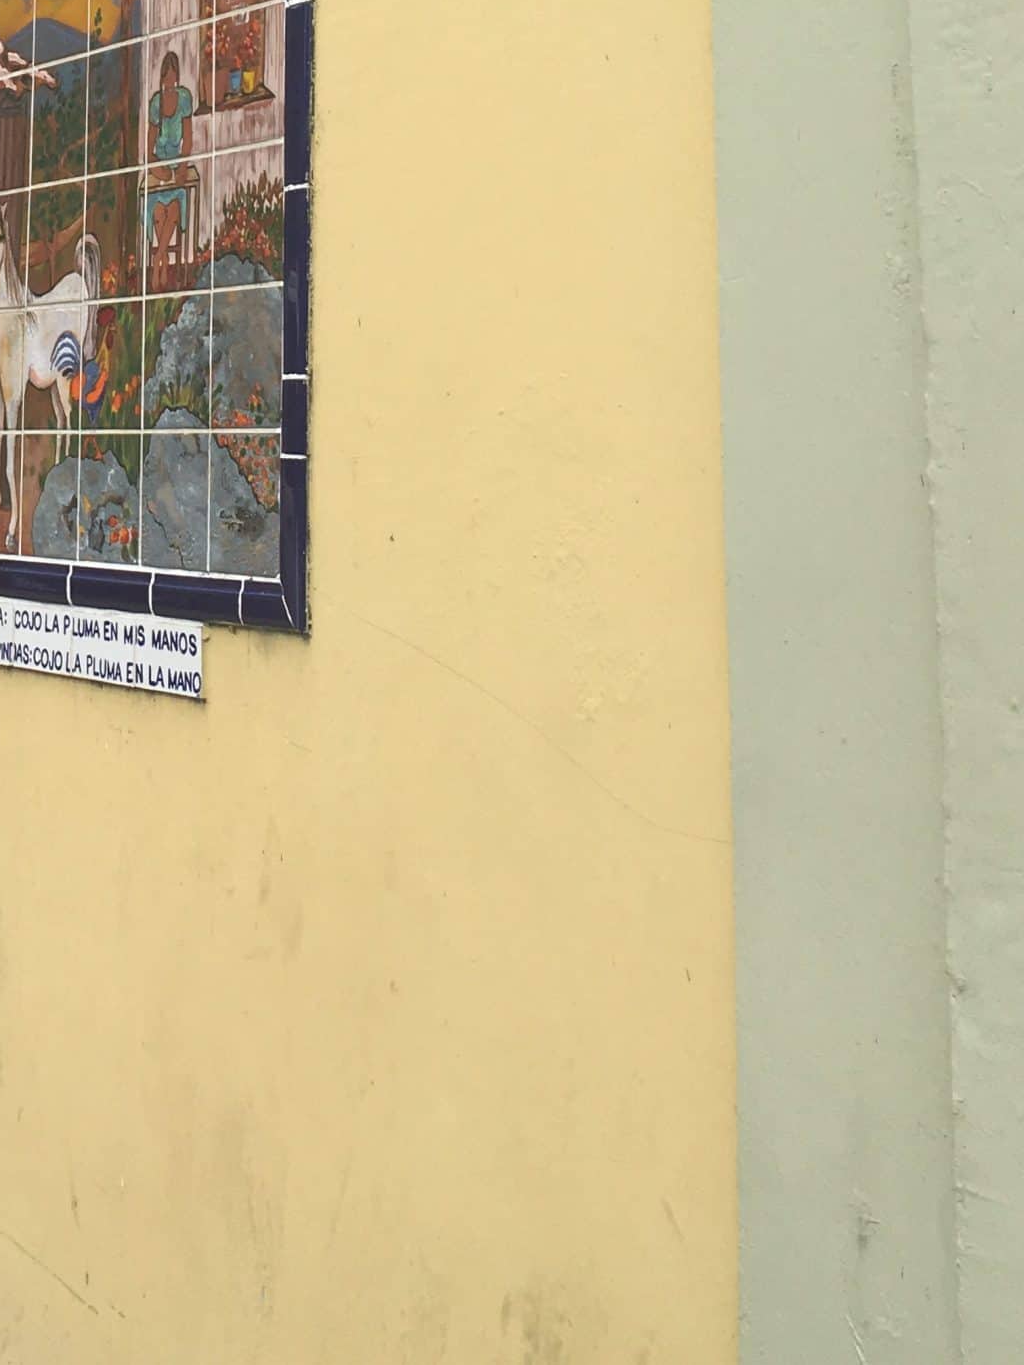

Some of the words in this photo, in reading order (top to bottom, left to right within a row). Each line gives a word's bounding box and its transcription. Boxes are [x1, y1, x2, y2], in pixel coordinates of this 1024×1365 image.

[14, 610, 42, 631] COJO
[45, 612, 60, 633] LA
[63, 614, 101, 639] PLUMA
[103, 620, 118, 642] EN
[123, 625, 146, 646] MIS
[151, 629, 198, 656] MANOS
[66, 651, 82, 673] LA
[86, 654, 123, 683] PLUMA
[126, 662, 144, 684] EN
[148, 664, 165, 688] LA
[167, 668, 202, 694] MANO
